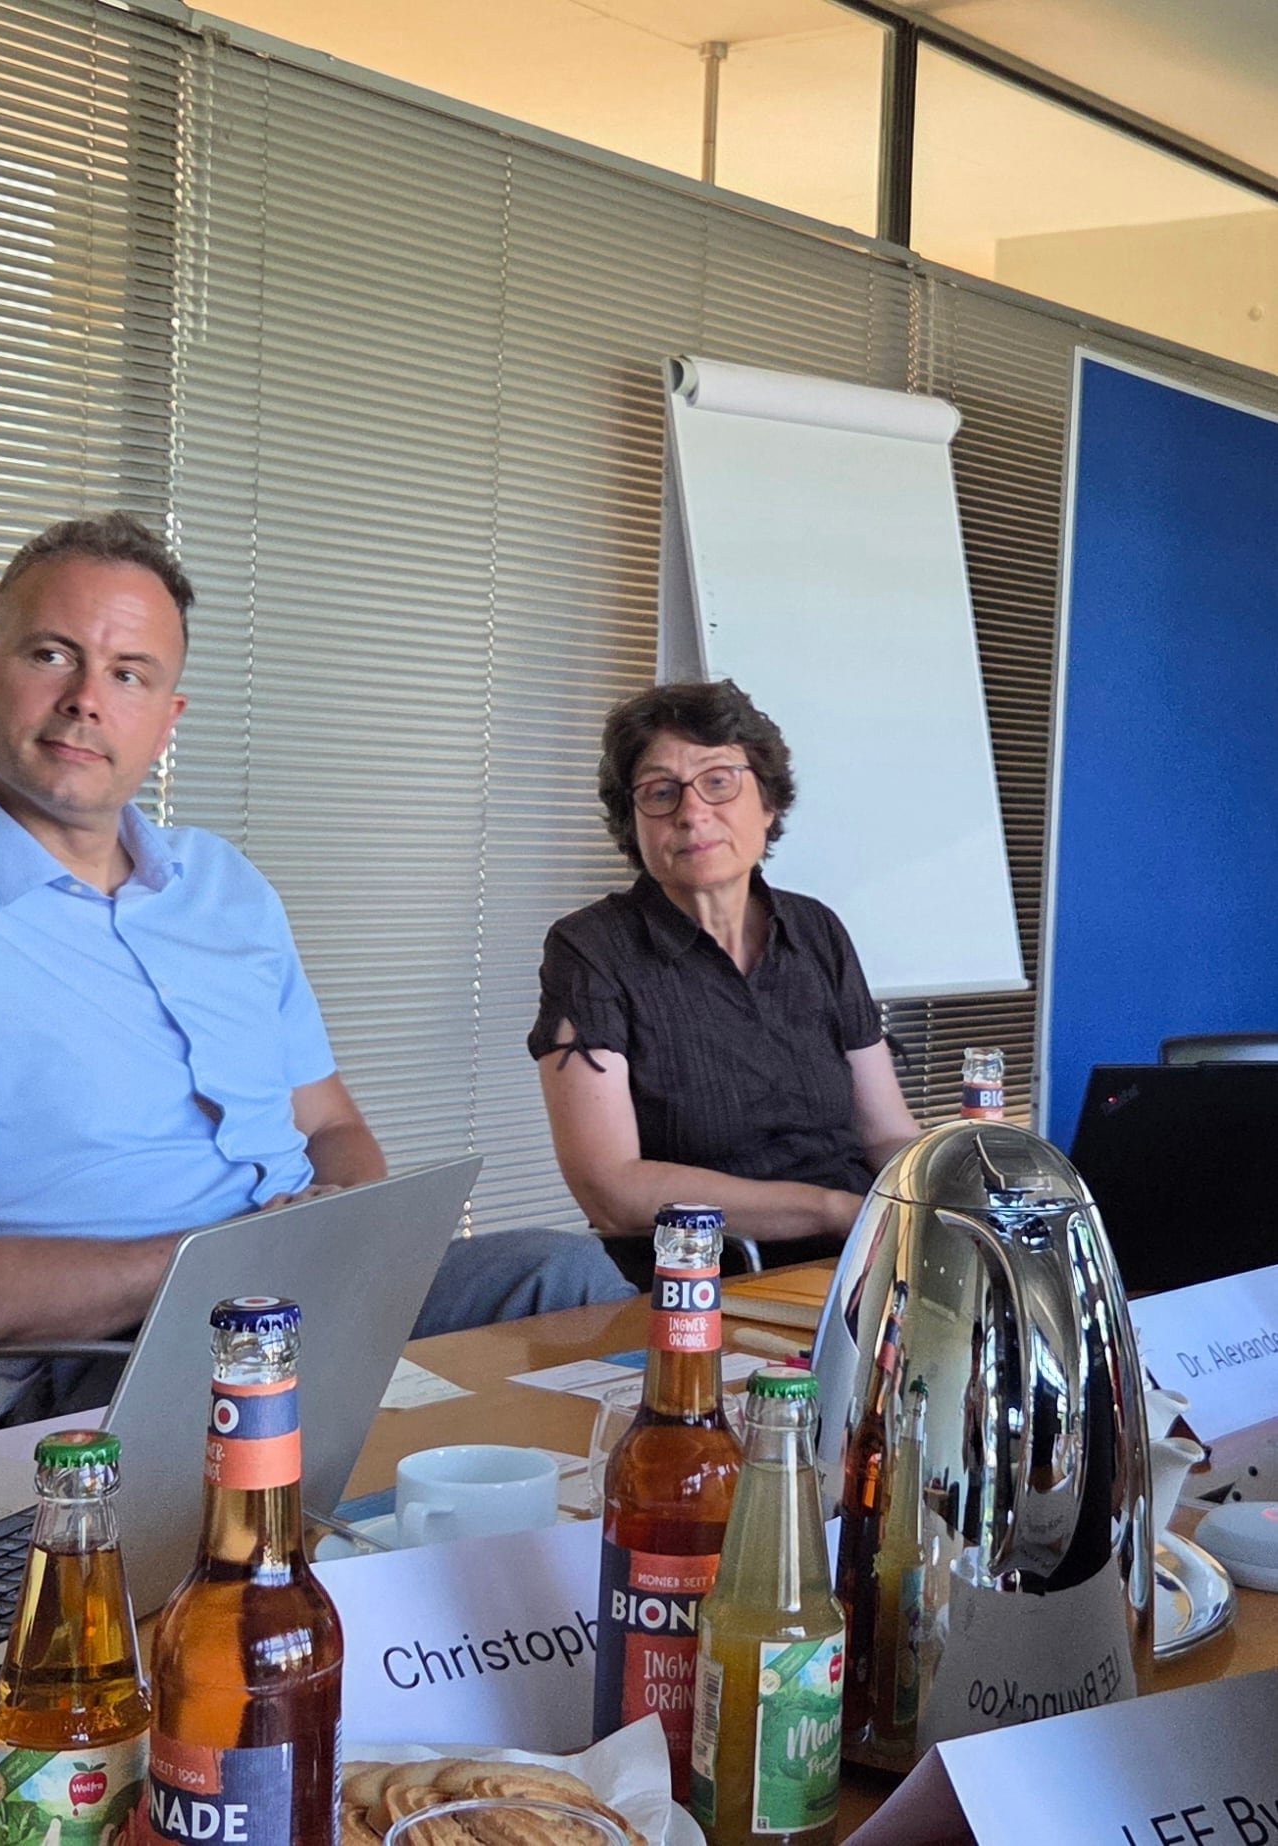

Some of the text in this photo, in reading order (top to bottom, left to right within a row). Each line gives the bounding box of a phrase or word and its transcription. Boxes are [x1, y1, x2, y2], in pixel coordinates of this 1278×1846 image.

[662, 1280, 715, 1309] BIO
[668, 1332, 709, 1348] ORANGE
[1176, 1352, 1213, 1378] Dr.
[683, 1575, 708, 1588] SEIT
[611, 1589, 698, 1632] BION
[383, 1611, 599, 1690] Christoph
[177, 1767, 206, 1786] 1994
[150, 1789, 249, 1843] NADE
